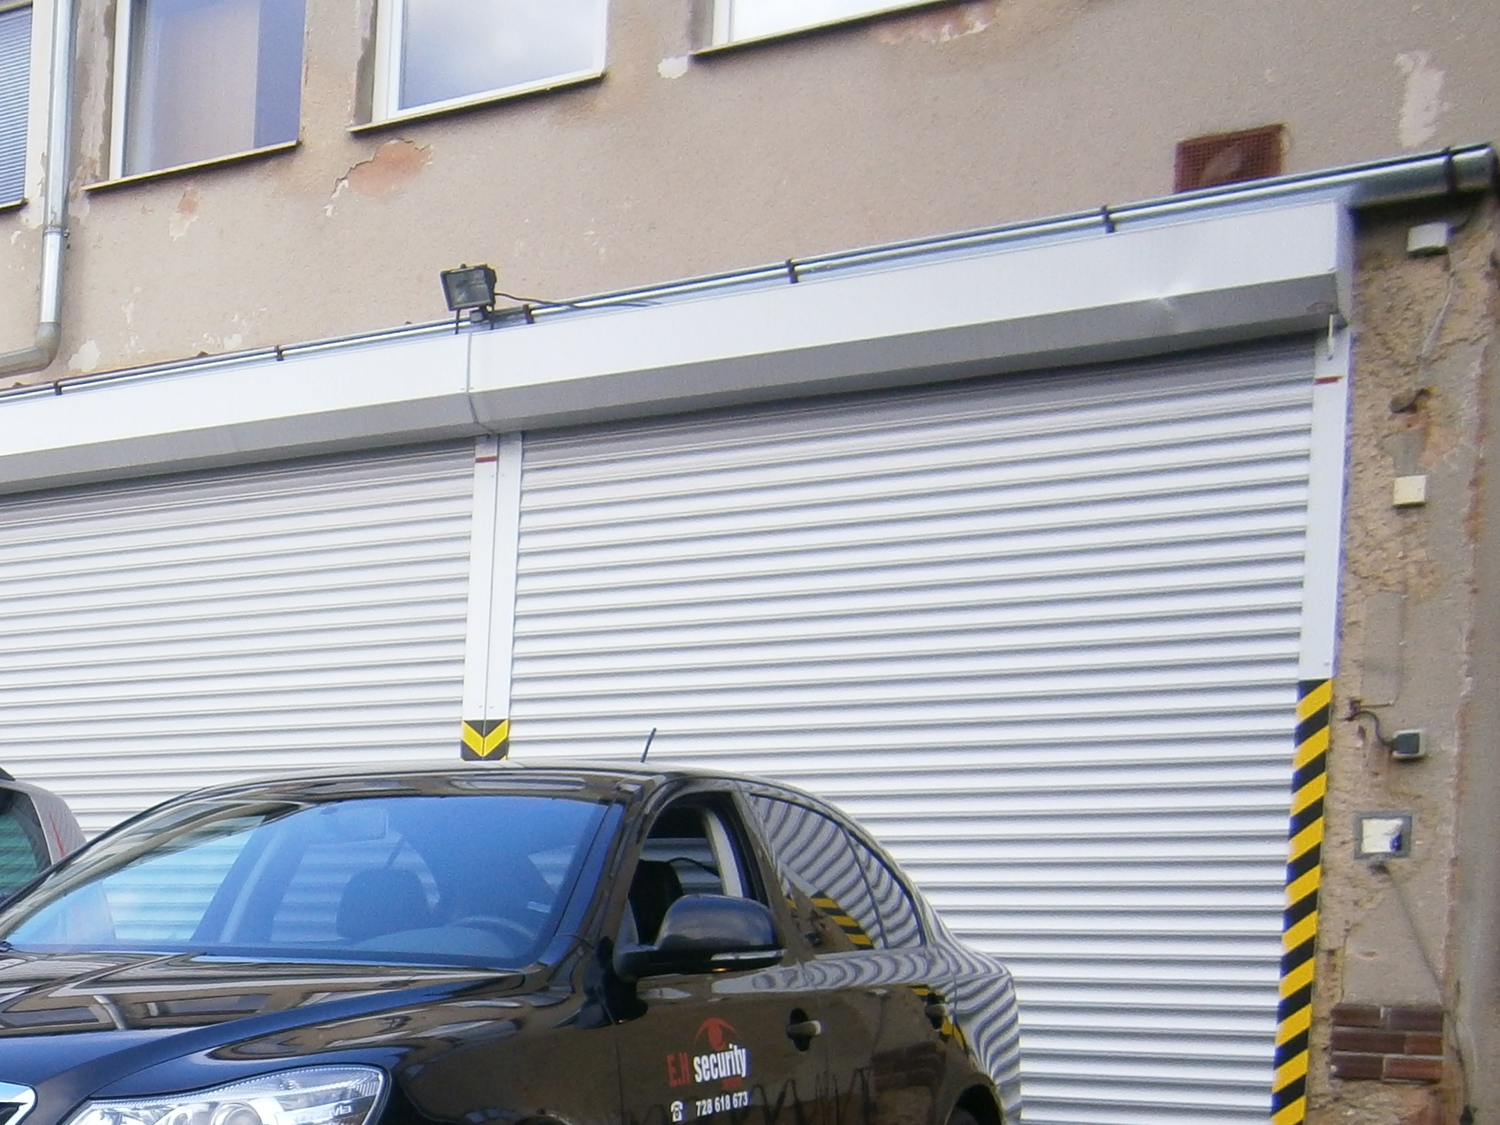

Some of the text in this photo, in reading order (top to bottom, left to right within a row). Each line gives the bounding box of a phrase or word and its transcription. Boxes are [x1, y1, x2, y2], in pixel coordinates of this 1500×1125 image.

[693, 1043, 747, 1083] security
[695, 1090, 749, 1118] 728 618 673
